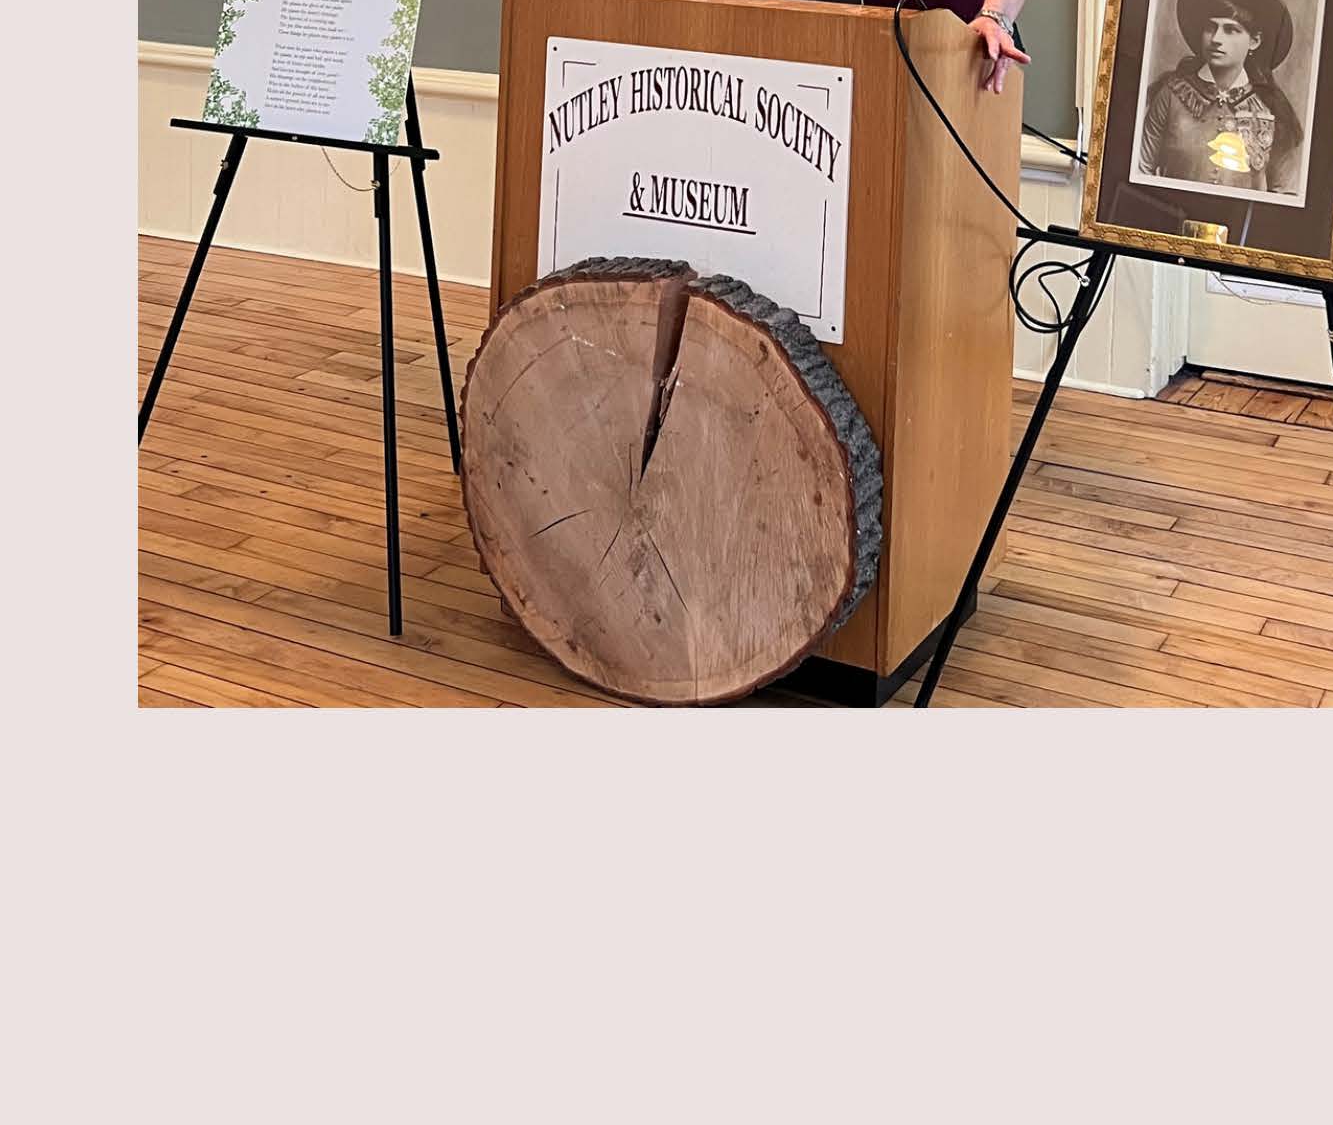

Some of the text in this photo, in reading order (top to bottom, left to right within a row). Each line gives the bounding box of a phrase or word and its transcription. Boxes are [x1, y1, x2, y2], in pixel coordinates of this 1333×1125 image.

[548, 67, 842, 184] NUTLEY HISTORICAL SOCIETY
[629, 171, 749, 228] & MUSEUM
